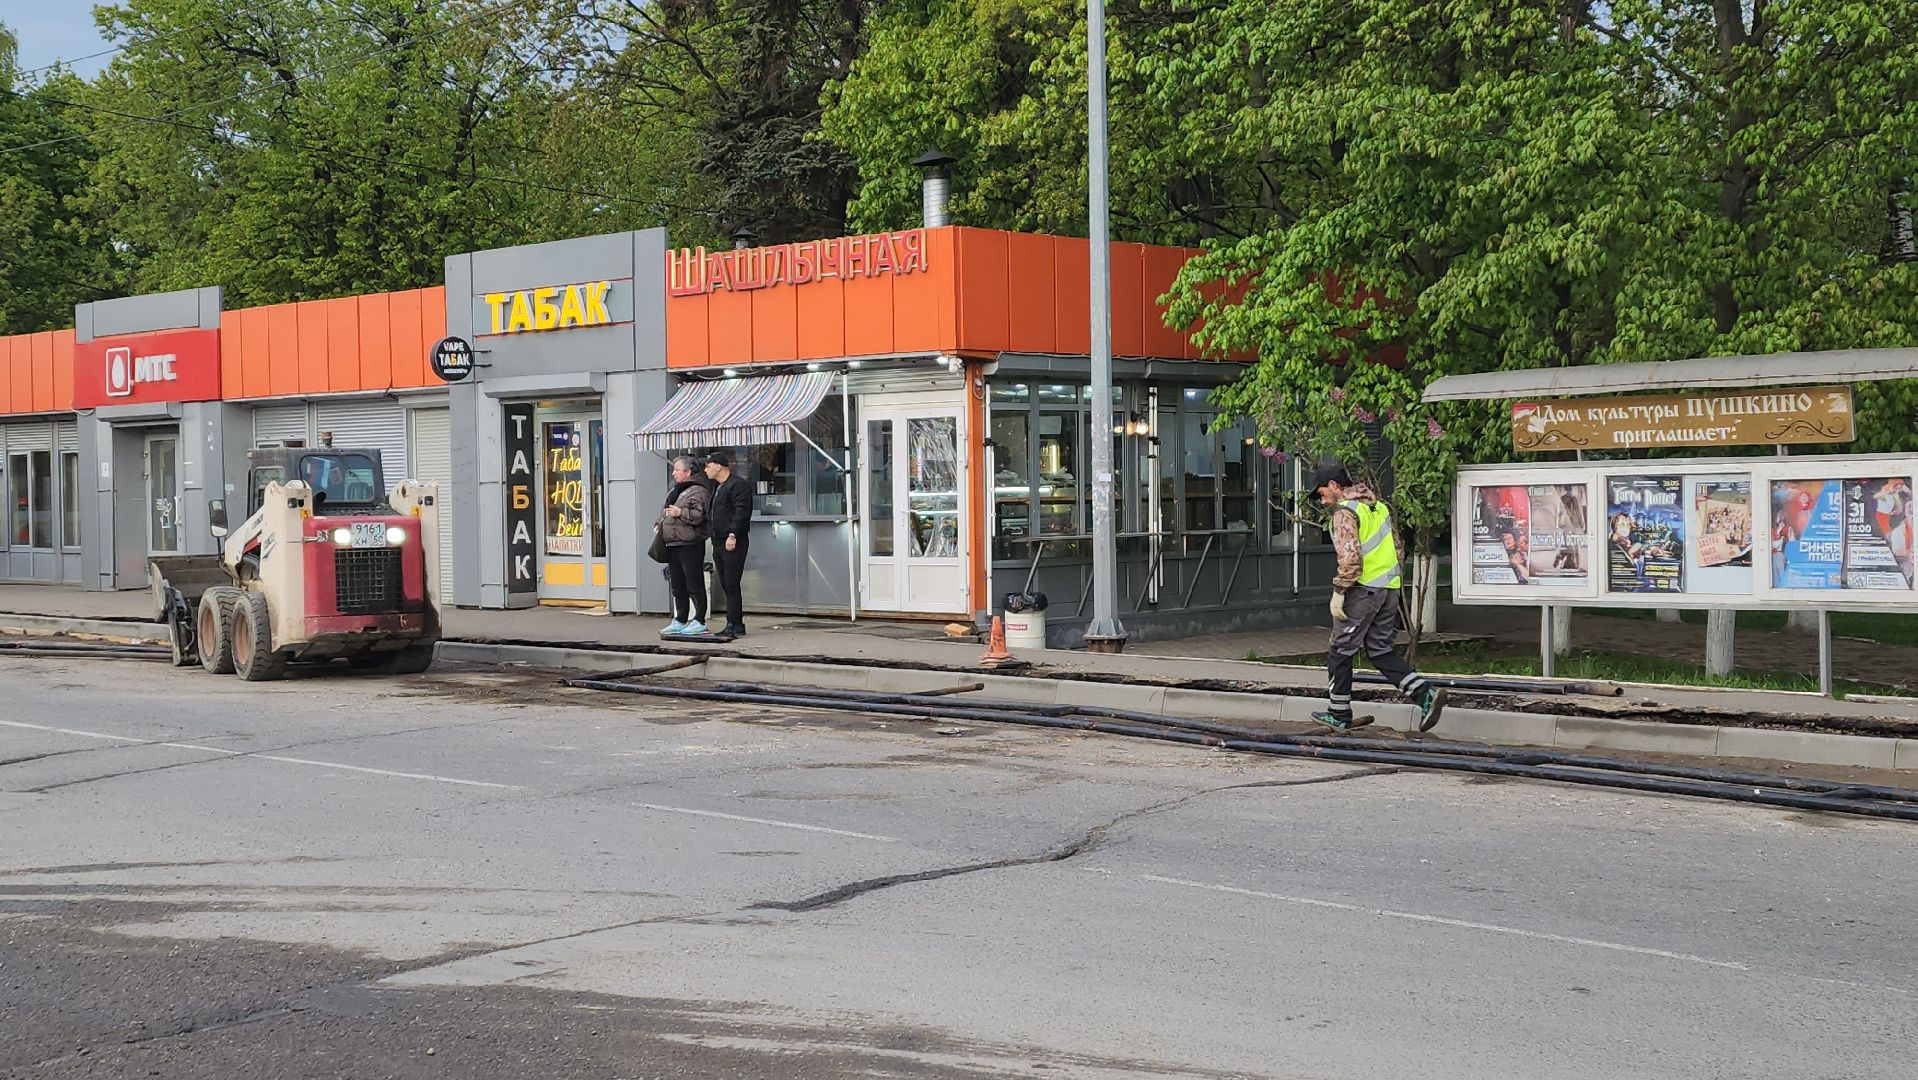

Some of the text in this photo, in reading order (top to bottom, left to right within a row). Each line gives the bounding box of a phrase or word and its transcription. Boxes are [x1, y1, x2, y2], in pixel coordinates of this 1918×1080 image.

[666, 229, 928, 297] ШАШЛЫЧНАЯ
[485, 281, 612, 334] ТАБАК
[443, 342, 465, 351] VAPE
[135, 354, 177, 382] МТС
[439, 353, 471, 366] ТАБАК
[1544, 393, 1813, 425] Дом культуры ПУШКИНО
[551, 448, 582, 473] Таба
[511, 415, 531, 579] ТАБАК
[1848, 502, 1865, 517] 31
[355, 524, 381, 534] 9161
[1848, 524, 1872, 533] 18:00
